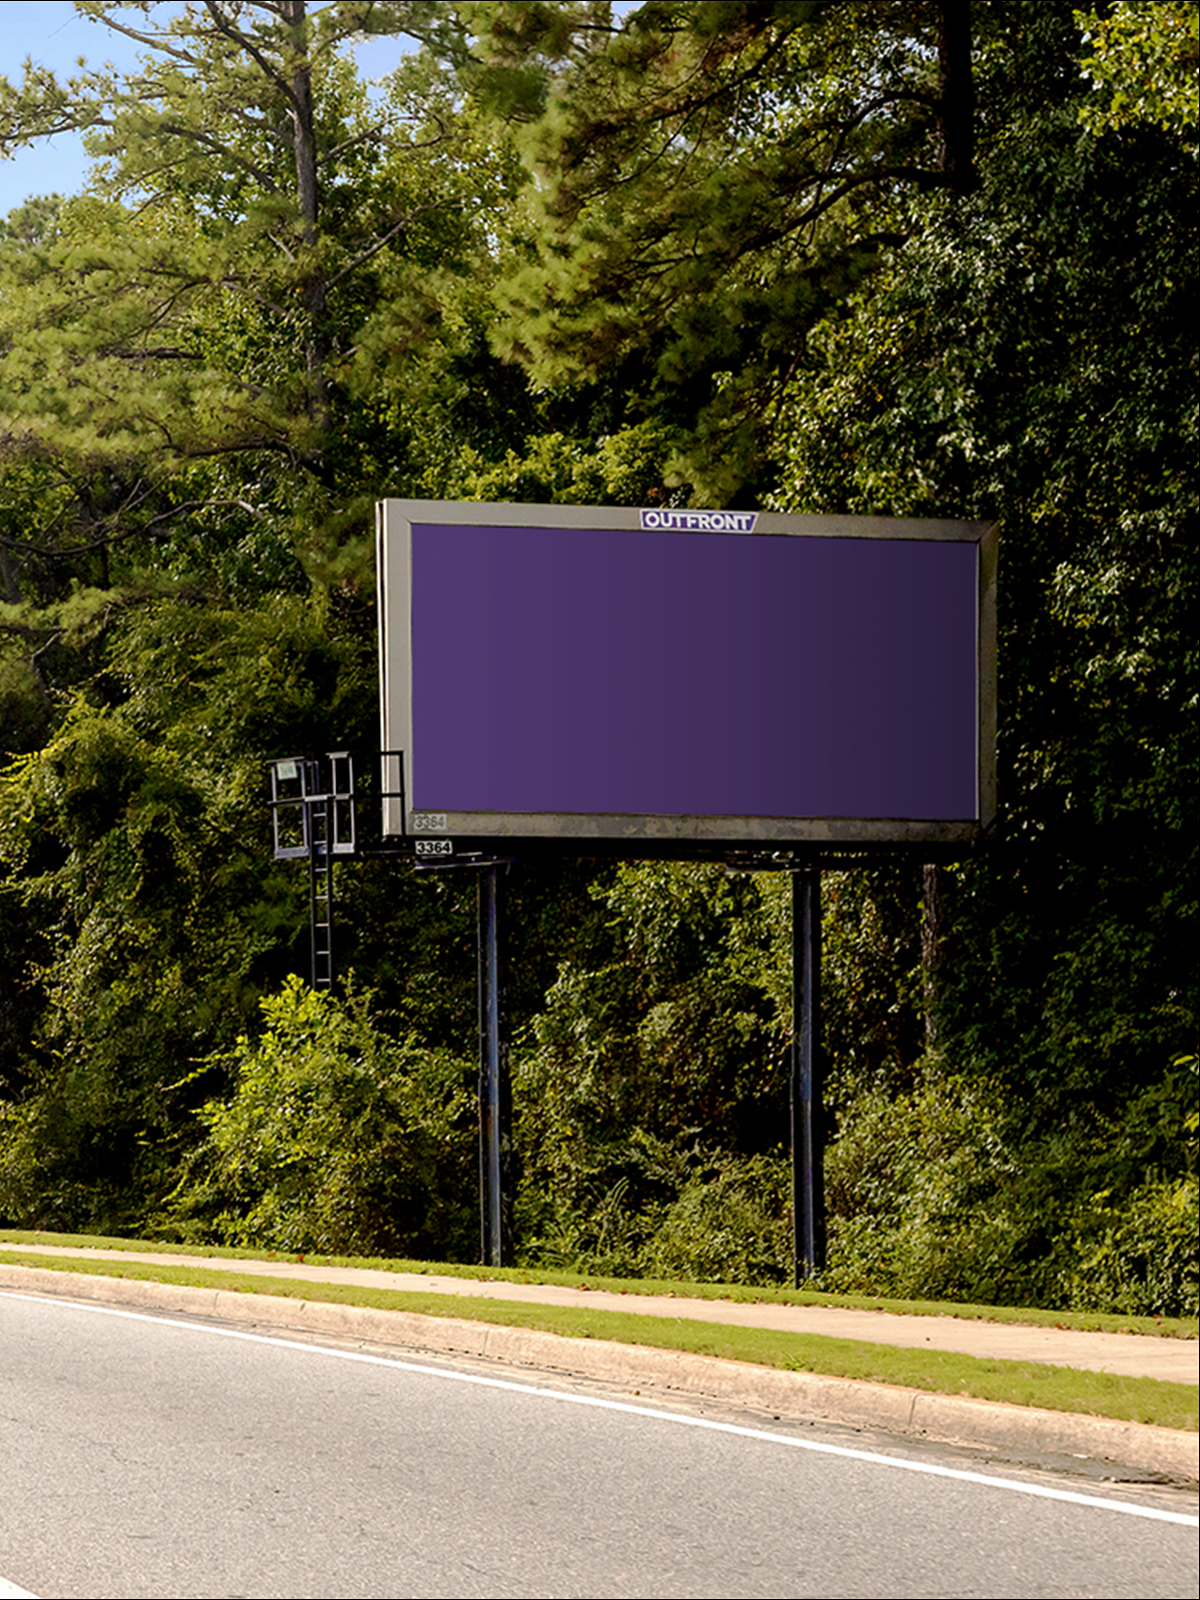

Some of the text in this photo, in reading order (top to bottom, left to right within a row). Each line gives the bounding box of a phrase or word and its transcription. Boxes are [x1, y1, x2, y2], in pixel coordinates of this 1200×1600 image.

[645, 512, 751, 530] OUTFRONT
[415, 815, 445, 828] 3364
[417, 842, 450, 853] 3364
